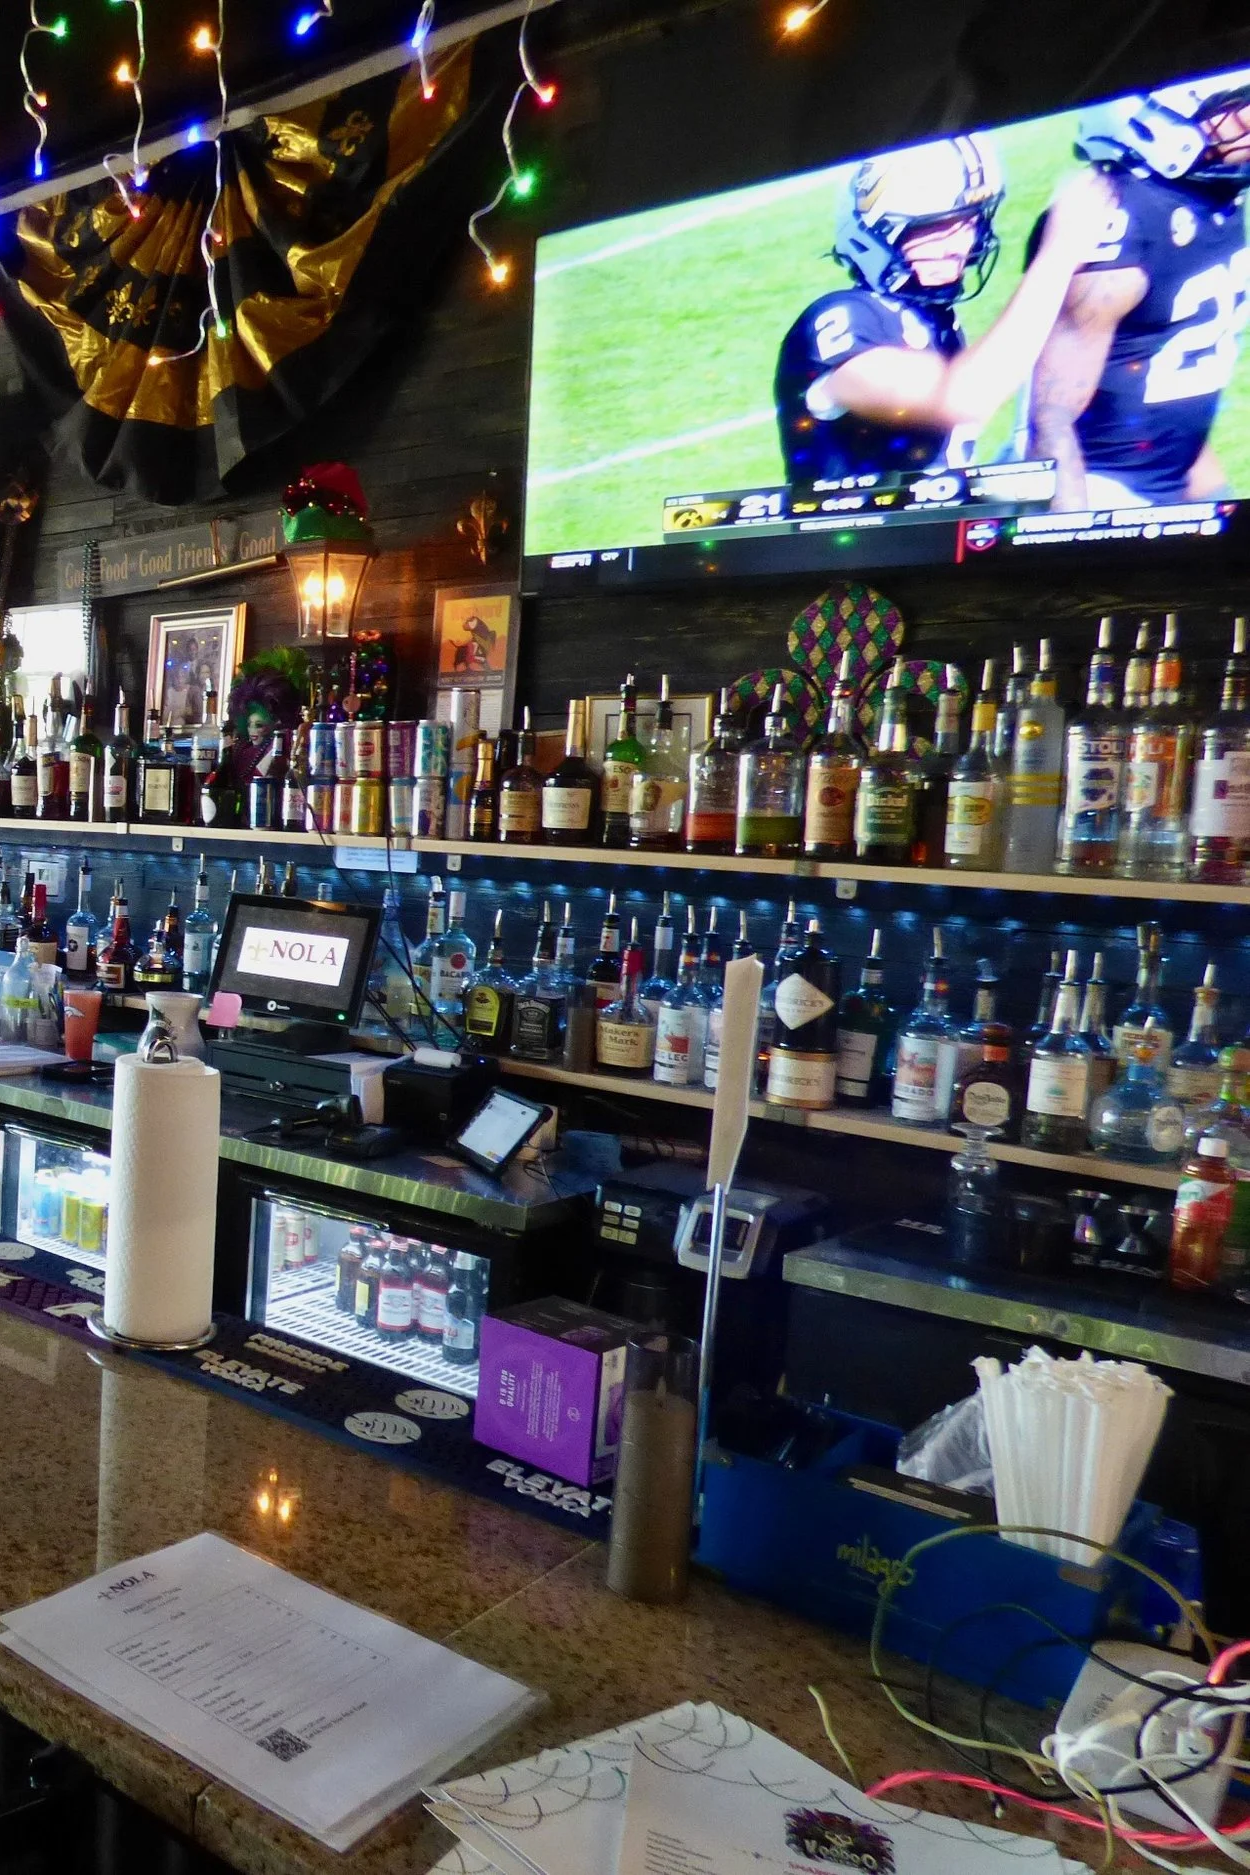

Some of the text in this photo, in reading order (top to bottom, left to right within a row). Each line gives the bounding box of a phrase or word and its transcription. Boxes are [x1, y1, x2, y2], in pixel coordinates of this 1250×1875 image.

[909, 476, 960, 502] 10
[740, 493, 781, 518] 21
[100, 553, 129, 582] Food
[139, 546, 173, 577] Good
[177, 542, 228, 571] Friens
[240, 527, 277, 560] Good
[269, 939, 338, 966] NOLA
[506, 1372, 516, 1408] QUALITY
[485, 1458, 613, 1512] ELEVAT
[503, 1476, 591, 1518] VODKA
[108, 1570, 156, 1593] NOLA
